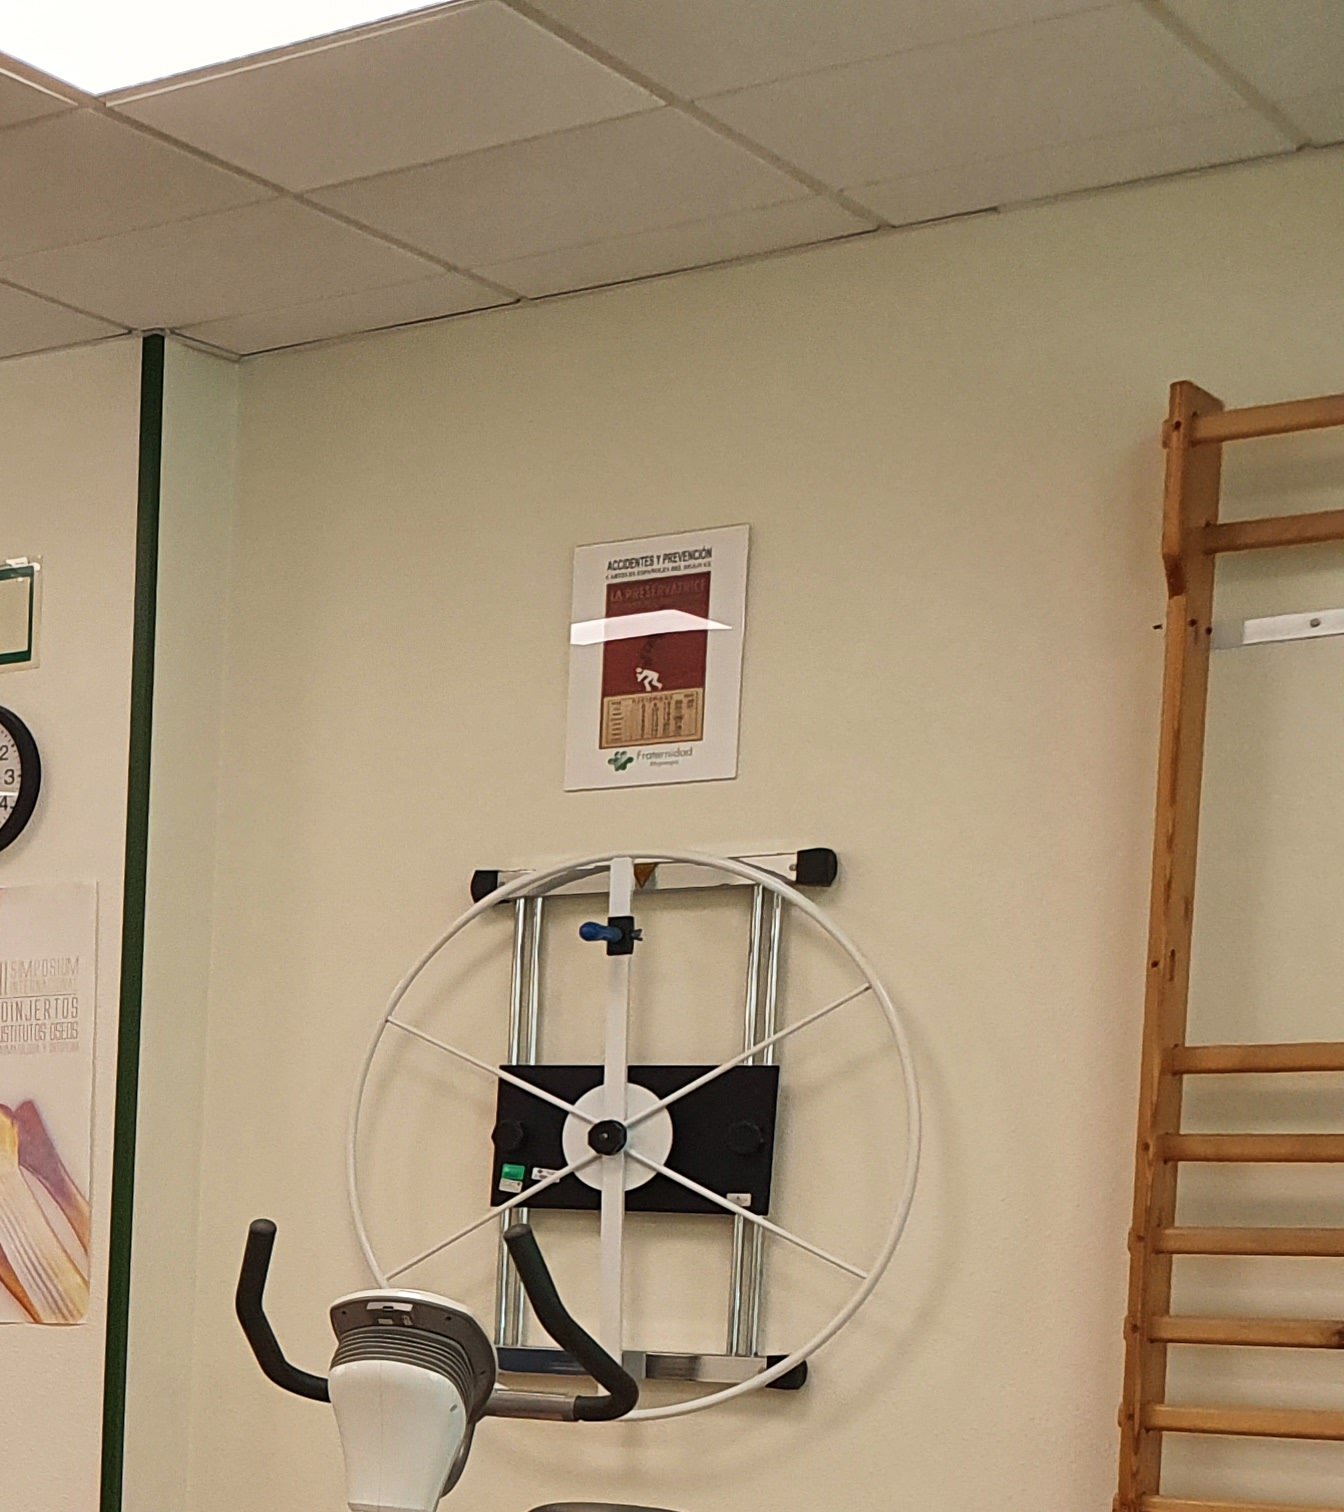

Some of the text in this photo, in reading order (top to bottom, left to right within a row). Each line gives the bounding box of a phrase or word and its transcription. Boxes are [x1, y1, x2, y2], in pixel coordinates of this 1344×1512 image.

[607, 555, 654, 571] ACCIDENTES
[662, 546, 712, 564] PREVENCIÓN
[0, 745, 9, 761] 2
[637, 747, 693, 760] Fraternidad
[4, 769, 15, 785] 3
